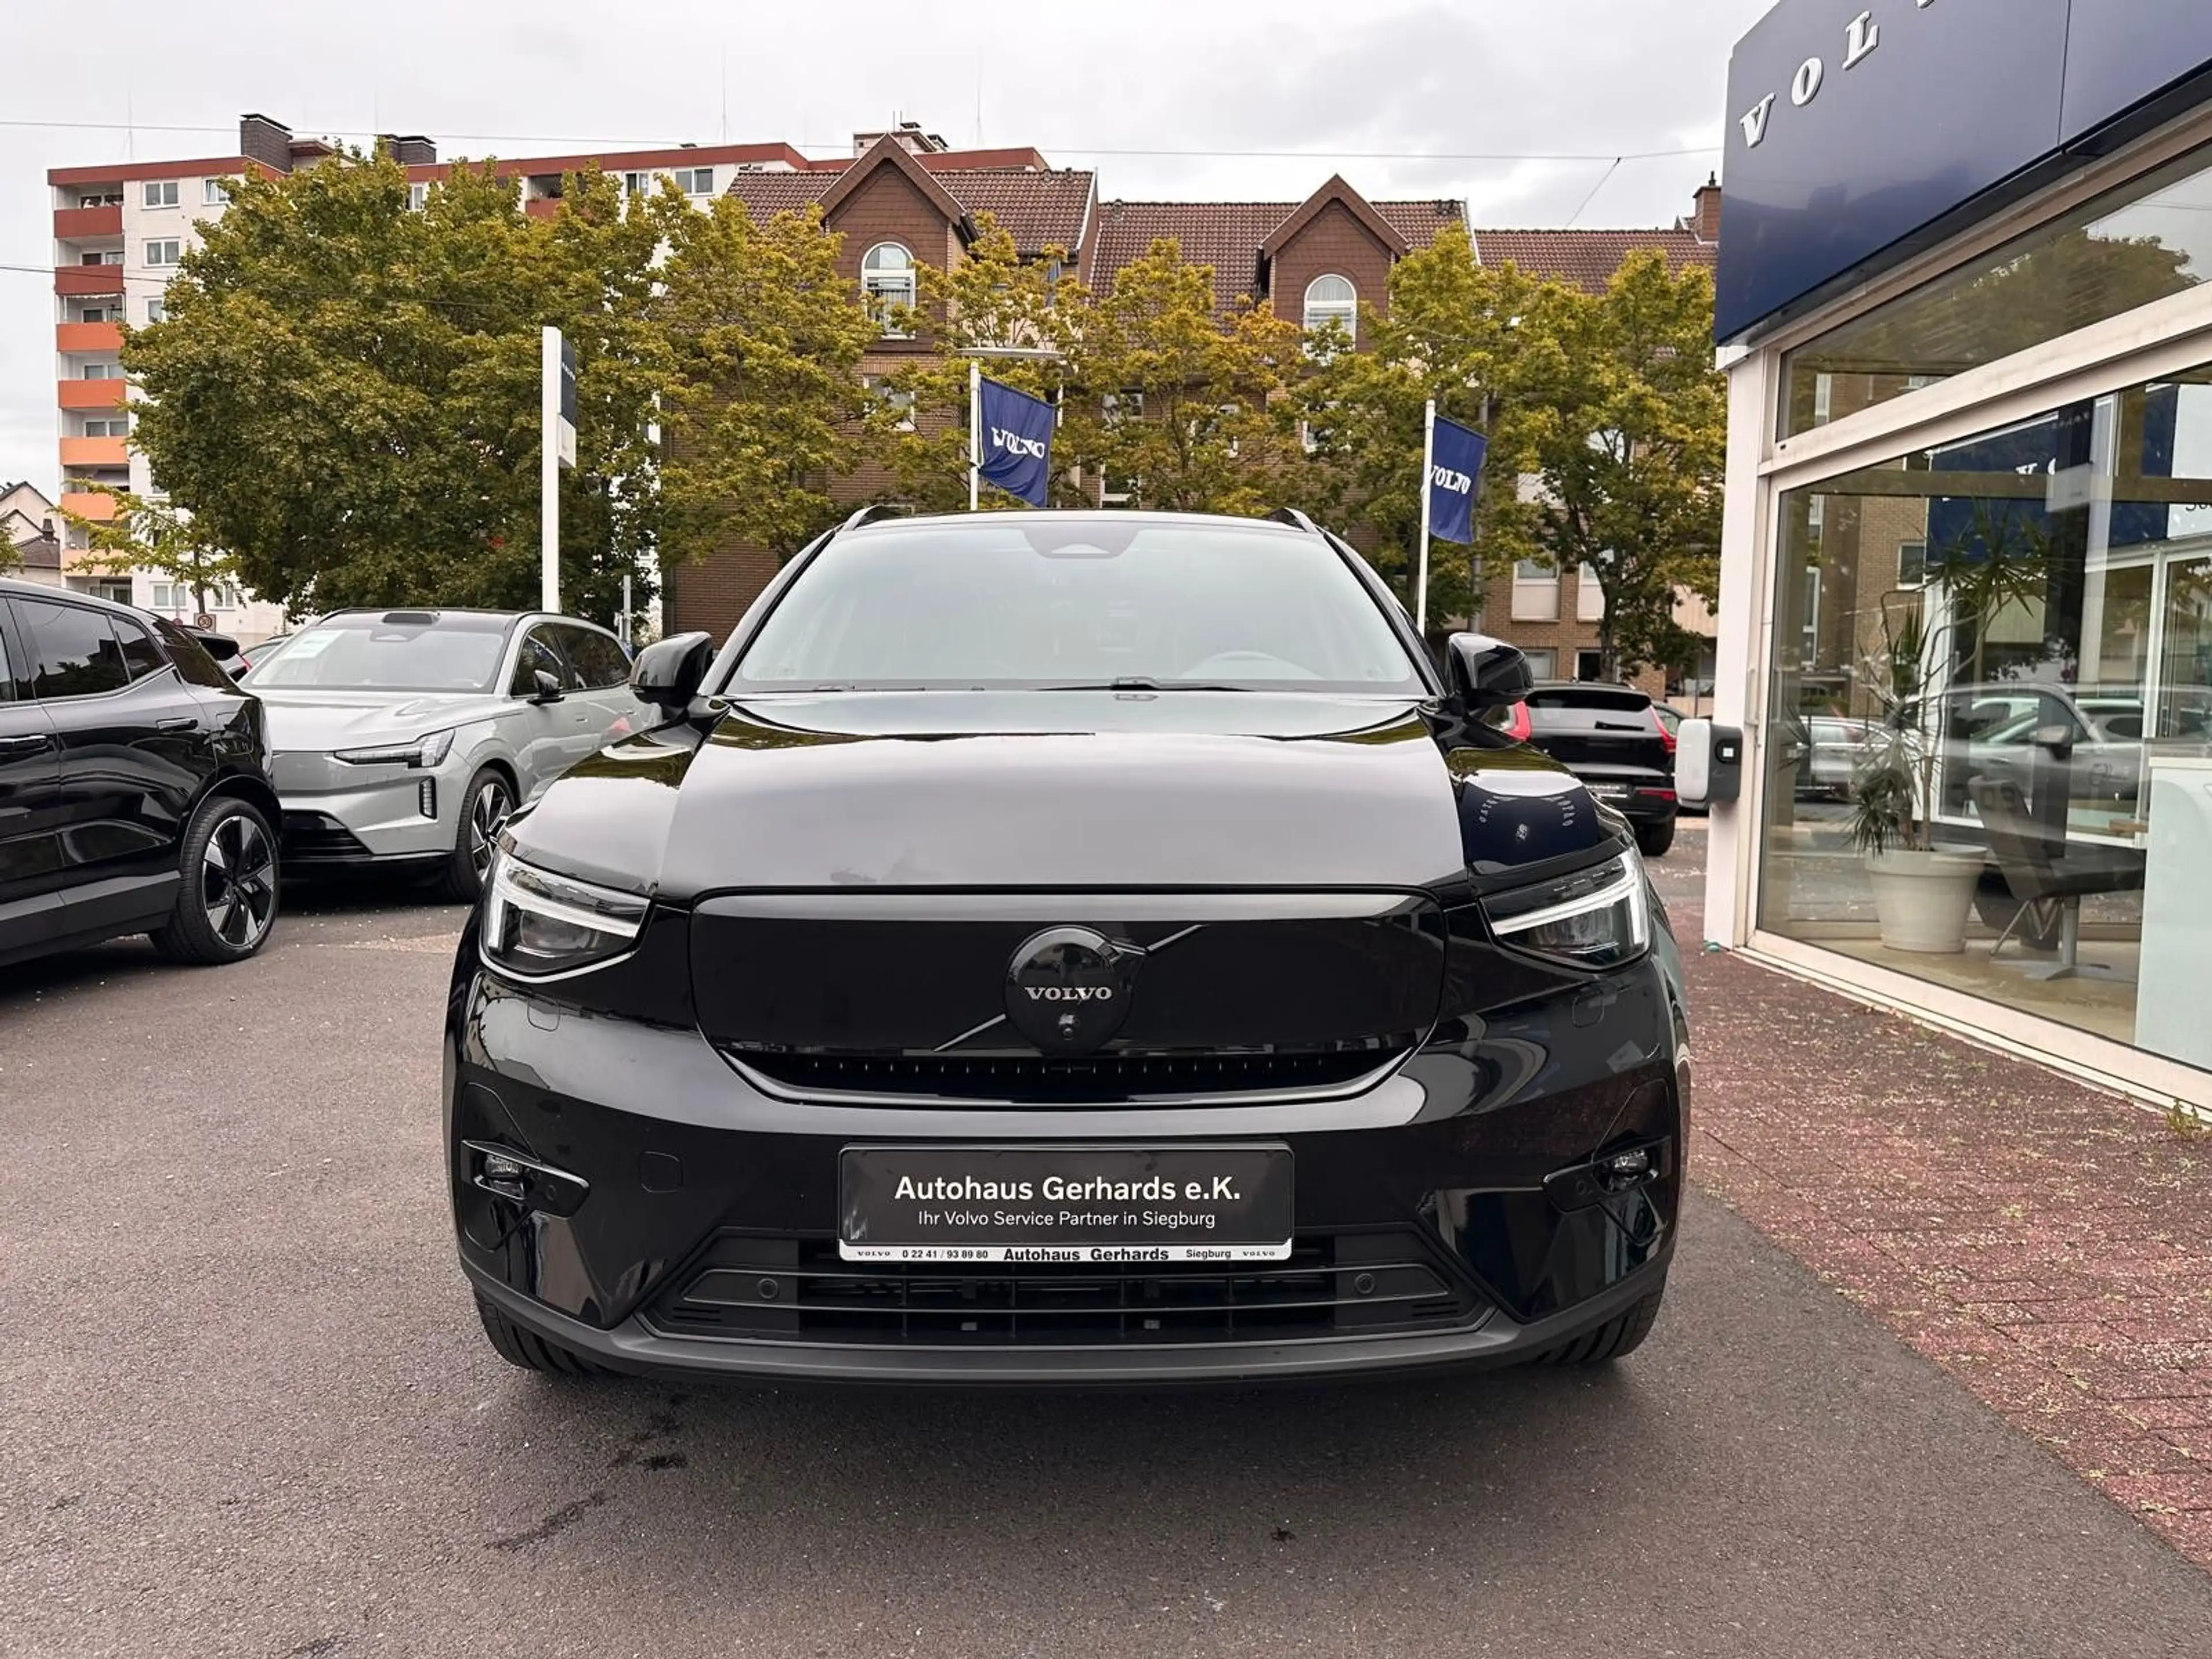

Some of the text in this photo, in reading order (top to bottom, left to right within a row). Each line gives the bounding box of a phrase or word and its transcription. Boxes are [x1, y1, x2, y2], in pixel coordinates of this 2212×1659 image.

[1738, 0, 1936, 149] VOL
[991, 426, 1046, 459] VOLVO
[1024, 986, 1112, 1001] VOLVO
[894, 1175, 1240, 1200] Autohaus Gerhards e.K.
[918, 1210, 1215, 1229] Ihr Volvo Service Partner in Siegburg
[1003, 1248, 1080, 1260] Autohaus
[1090, 1248, 1169, 1260] Gerhards
[1185, 1249, 1232, 1260] Siegburg
